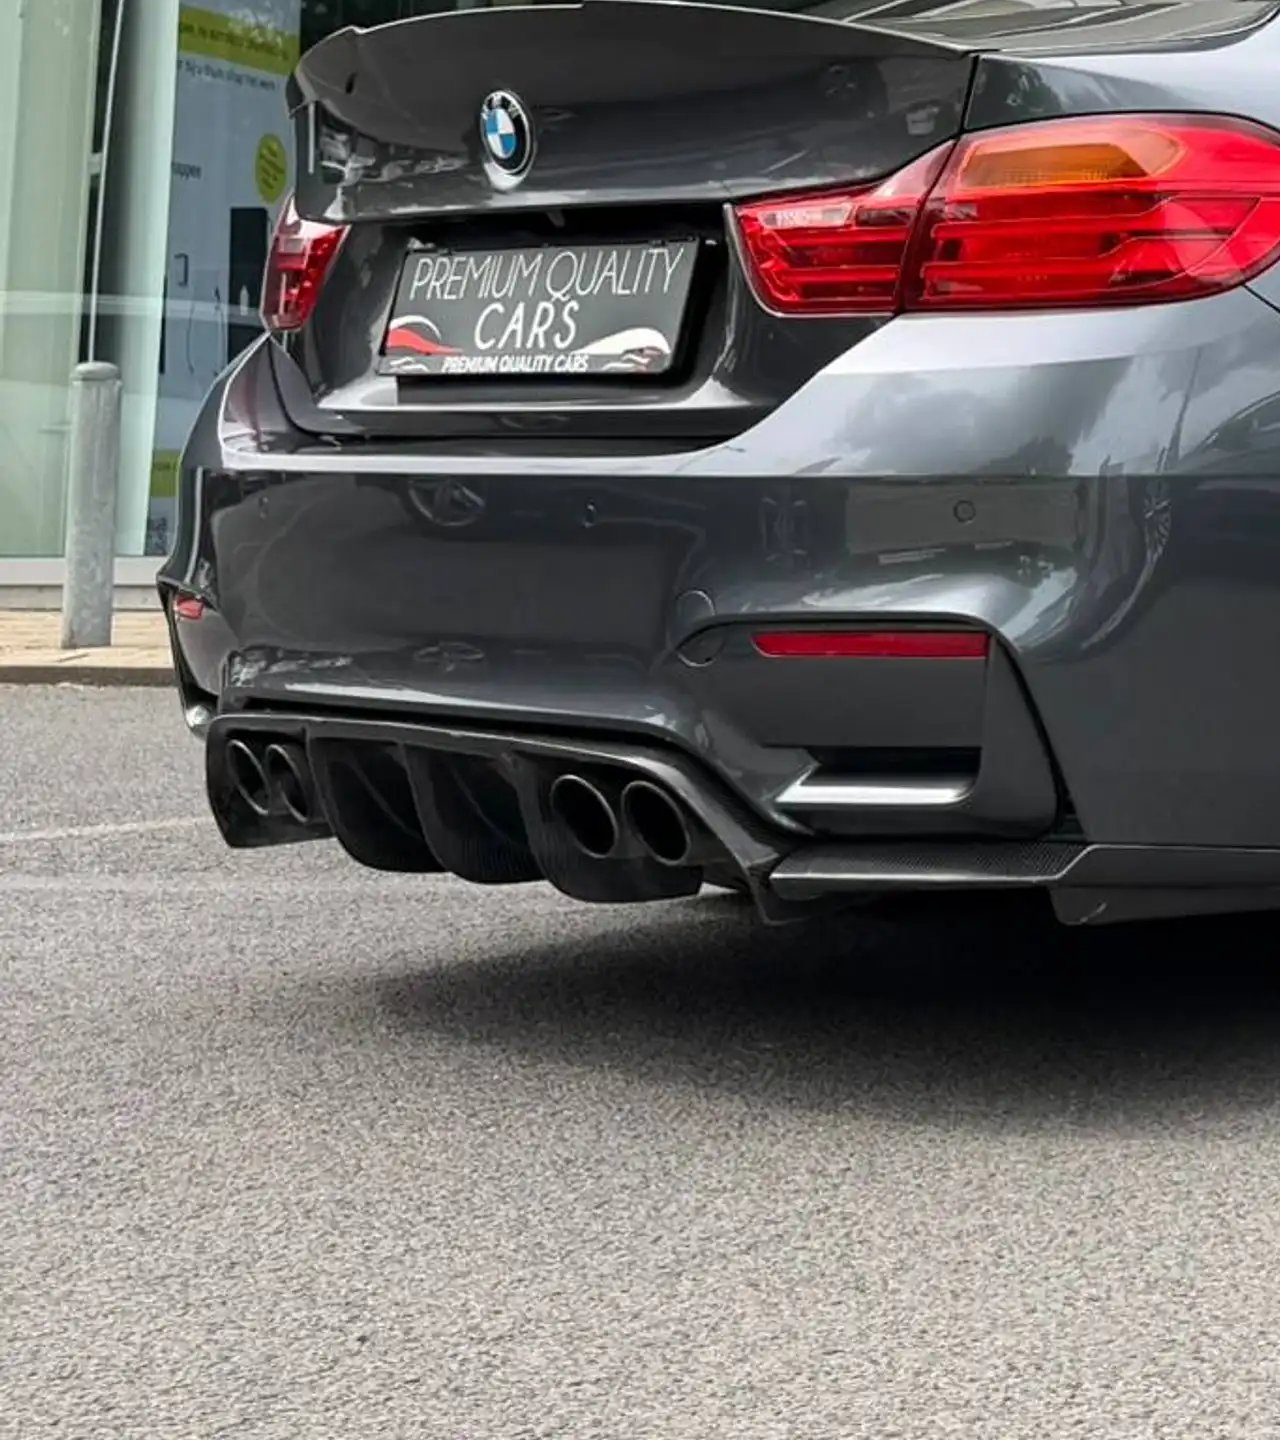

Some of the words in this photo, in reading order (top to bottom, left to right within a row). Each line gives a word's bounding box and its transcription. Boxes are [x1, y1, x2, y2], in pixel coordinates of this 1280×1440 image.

[409, 251, 544, 301] PREMIUM
[545, 246, 685, 302] QUALITY
[474, 300, 580, 350] CARS
[441, 354, 498, 373] PREMIUM
[498, 353, 554, 373] QUALITY
[554, 352, 590, 373] CARS
